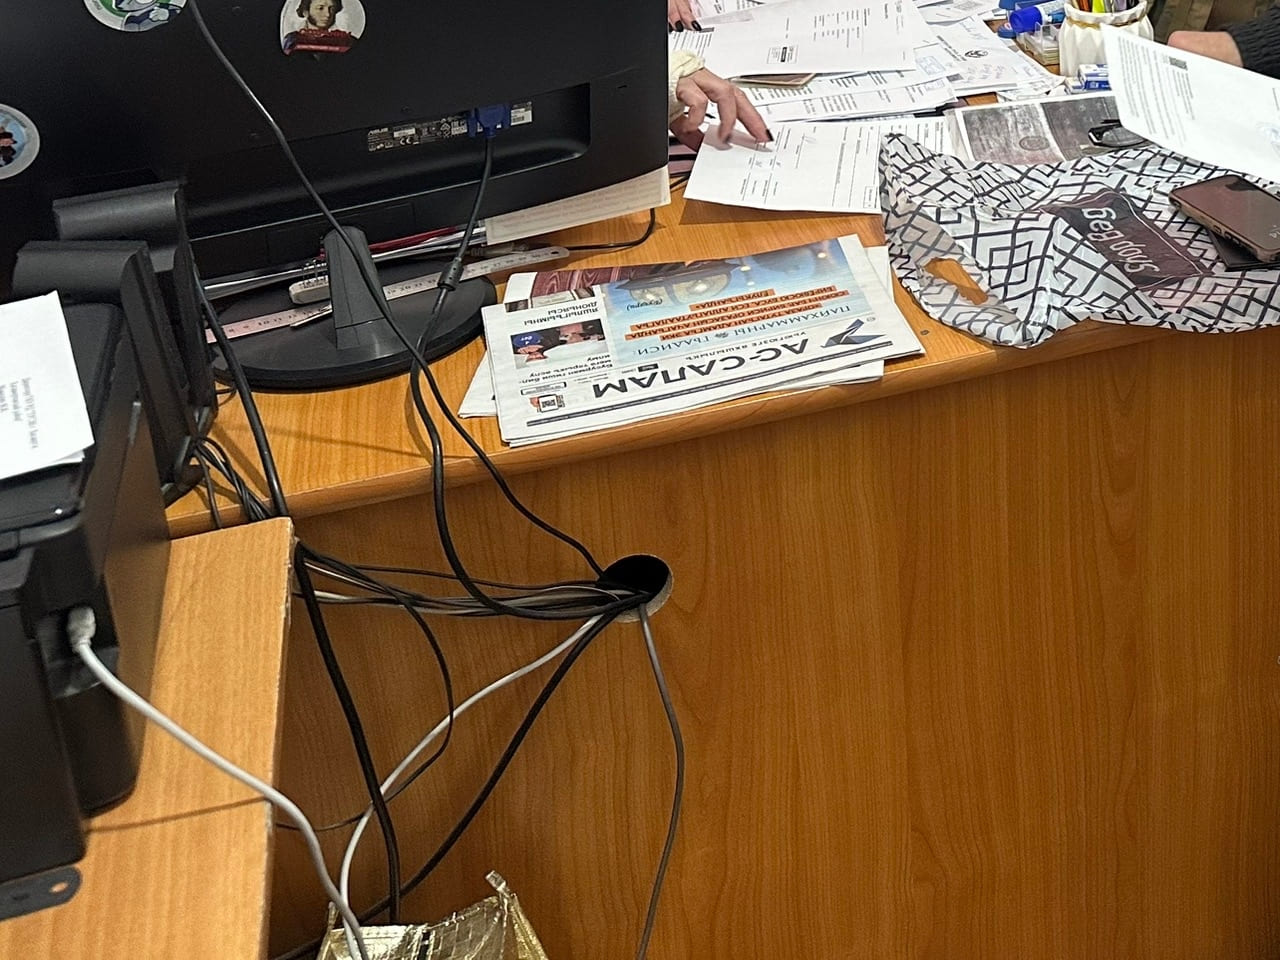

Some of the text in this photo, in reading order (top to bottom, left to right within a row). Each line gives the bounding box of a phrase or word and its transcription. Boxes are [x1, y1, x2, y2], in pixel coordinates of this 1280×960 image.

[1079, 205, 1160, 274] Shop Bag
[523, 307, 599, 325] ЯШЛЫГЪЫМНЫ
[547, 301, 597, 315] ДЮНЬЯСЫ
[733, 305, 850, 335] ПАЙХАММАРНЫ
[661, 331, 682, 340] ЭКИ
[567, 363, 613, 375] Бусурман
[593, 338, 808, 399] АС-САЛАМ
